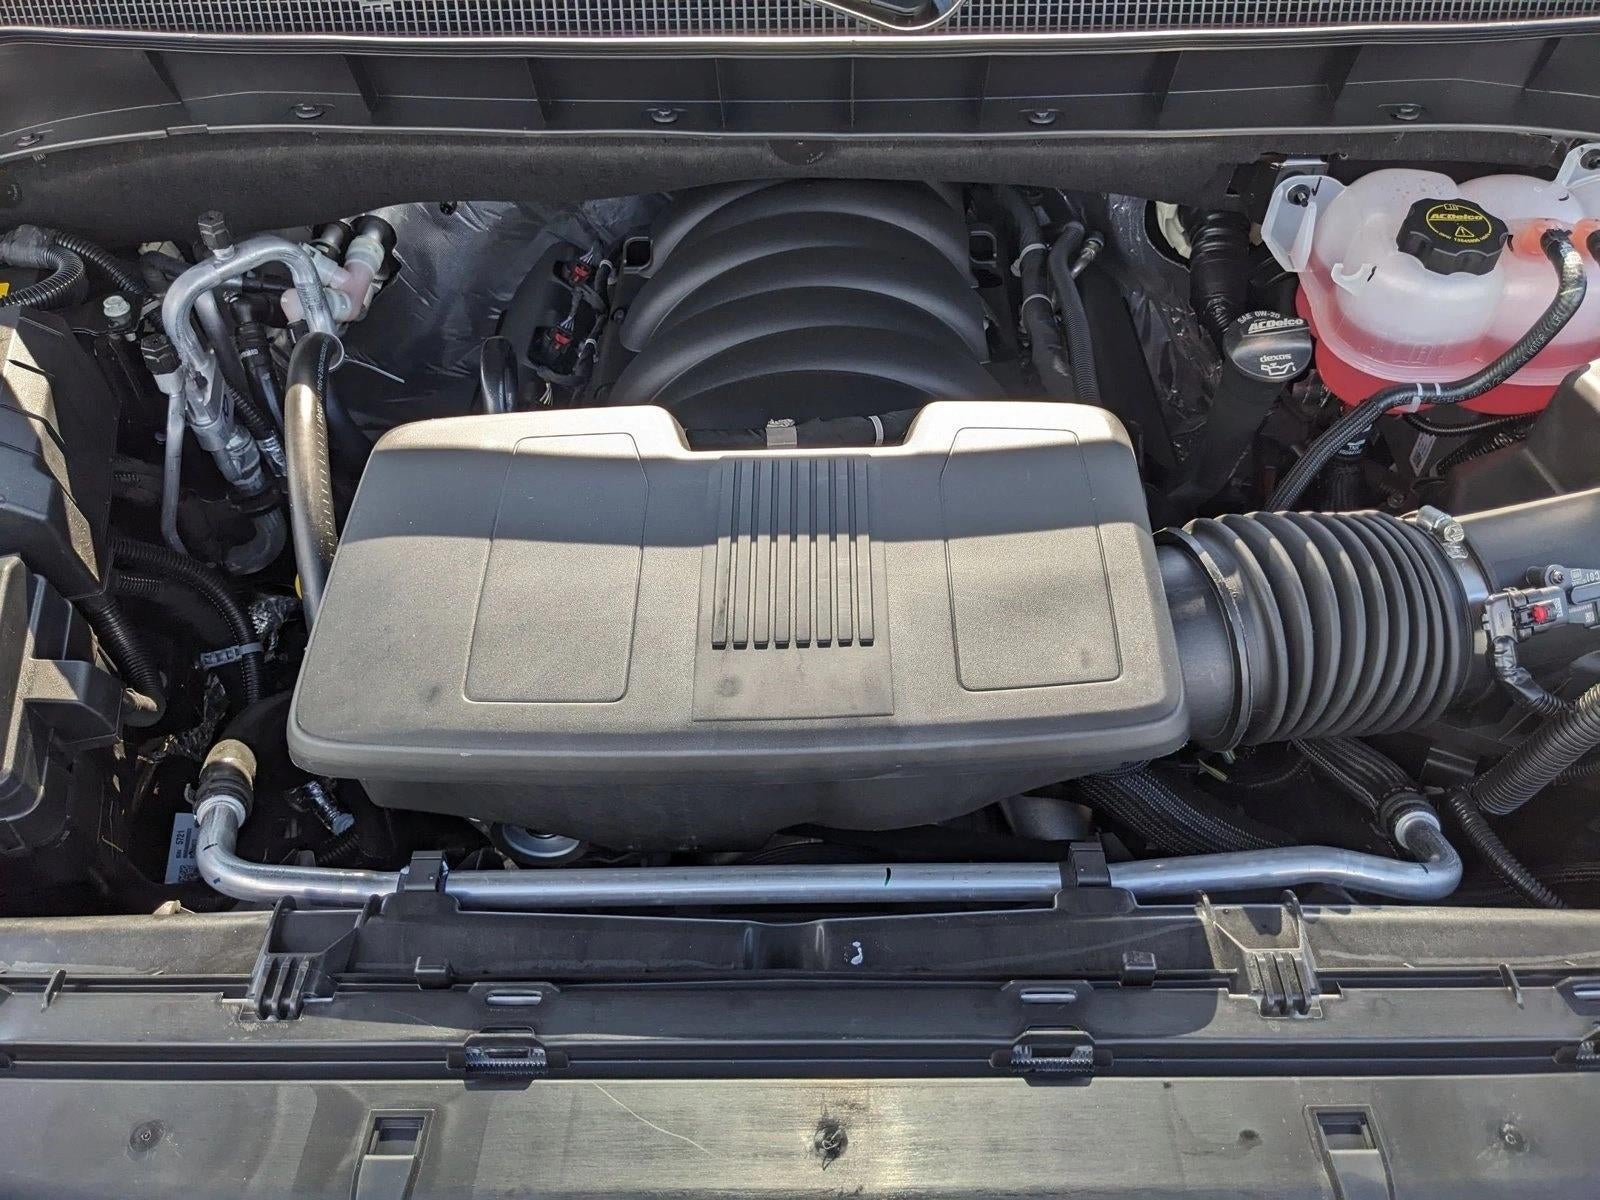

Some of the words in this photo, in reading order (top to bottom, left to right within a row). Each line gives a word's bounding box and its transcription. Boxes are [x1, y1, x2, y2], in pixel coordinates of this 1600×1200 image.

[1429, 213, 1483, 221] ACDelco
[1237, 312, 1253, 324] SAE
[1254, 310, 1281, 319] 0W-20
[1248, 318, 1304, 331] ACDelco
[175, 830, 185, 845] 5721
